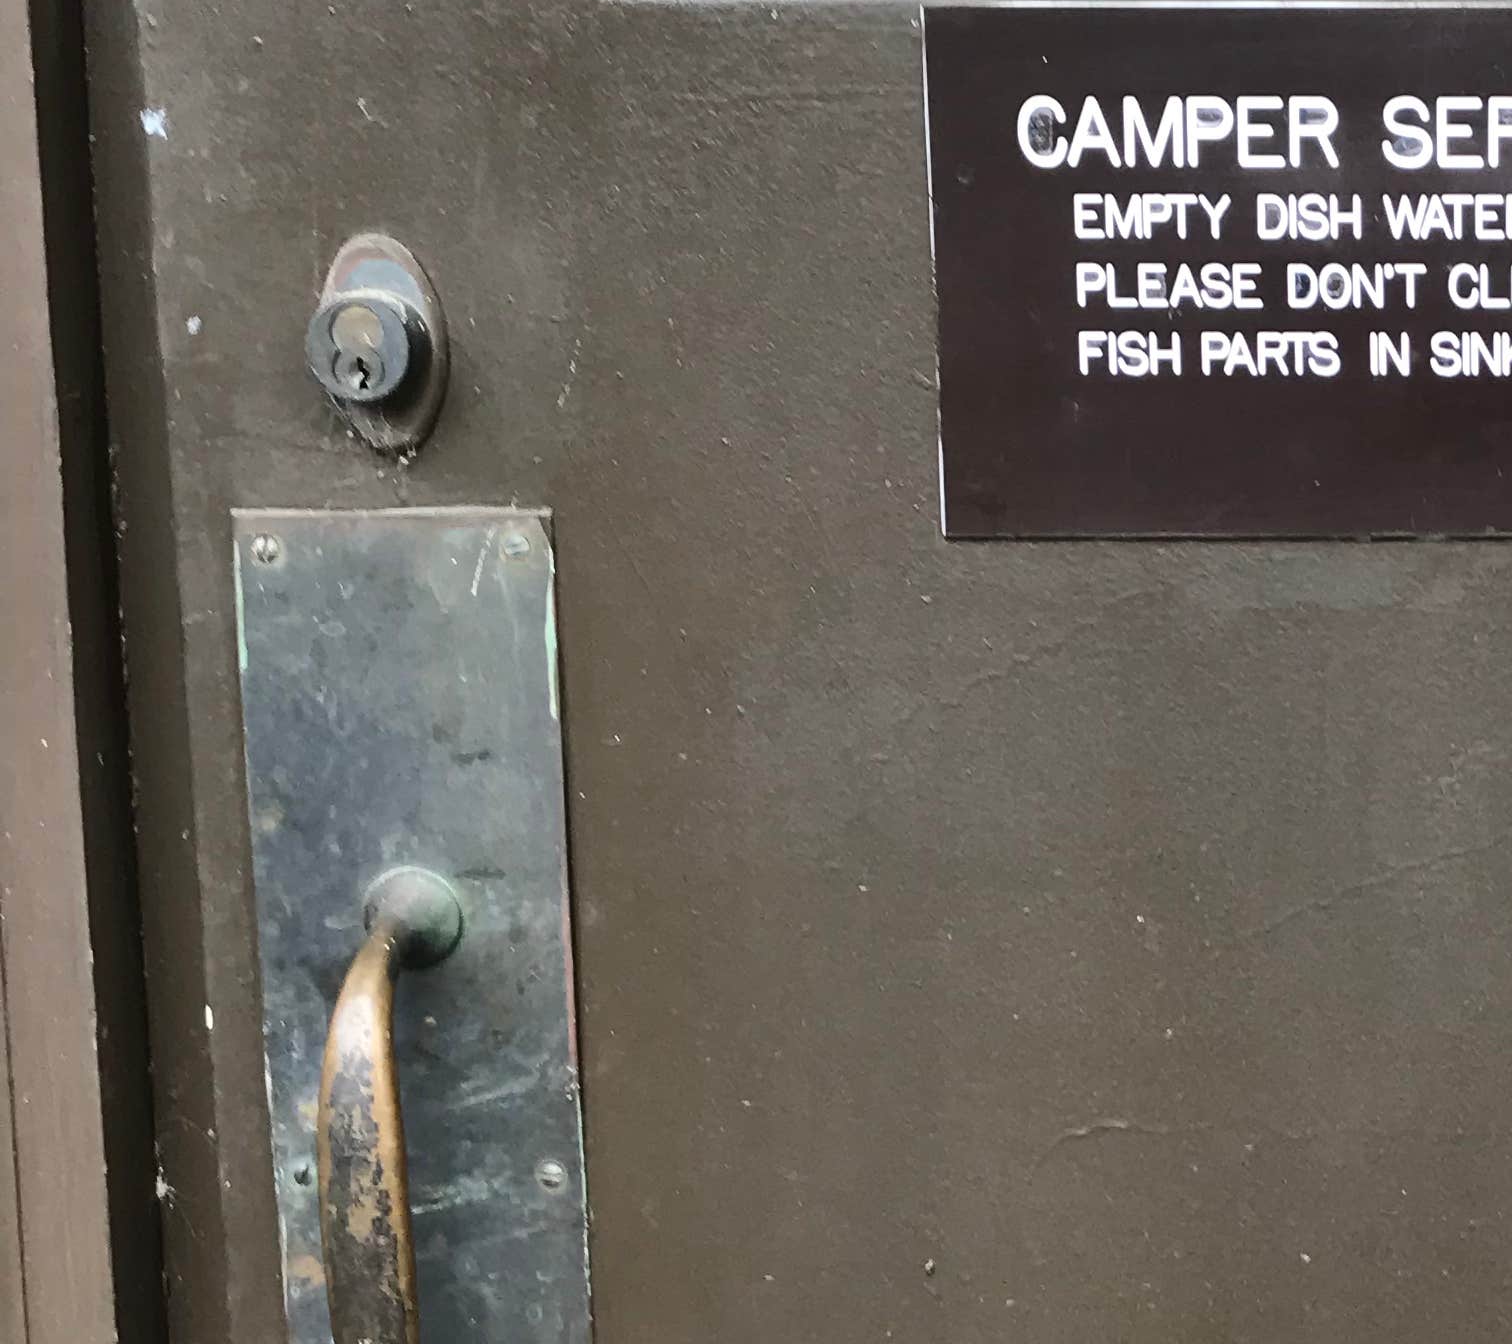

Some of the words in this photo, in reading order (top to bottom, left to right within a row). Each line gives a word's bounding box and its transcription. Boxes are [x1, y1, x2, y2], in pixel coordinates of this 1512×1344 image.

[1017, 94, 1340, 169] CAMPER
[1073, 193, 1232, 240] EMPTY
[1256, 192, 1363, 242] DISH
[1075, 262, 1264, 310] PLEASE
[1286, 262, 1428, 310] DON'T
[1078, 330, 1182, 377] FISH
[1200, 330, 1342, 378] PARTS
[1369, 331, 1411, 377] IN
